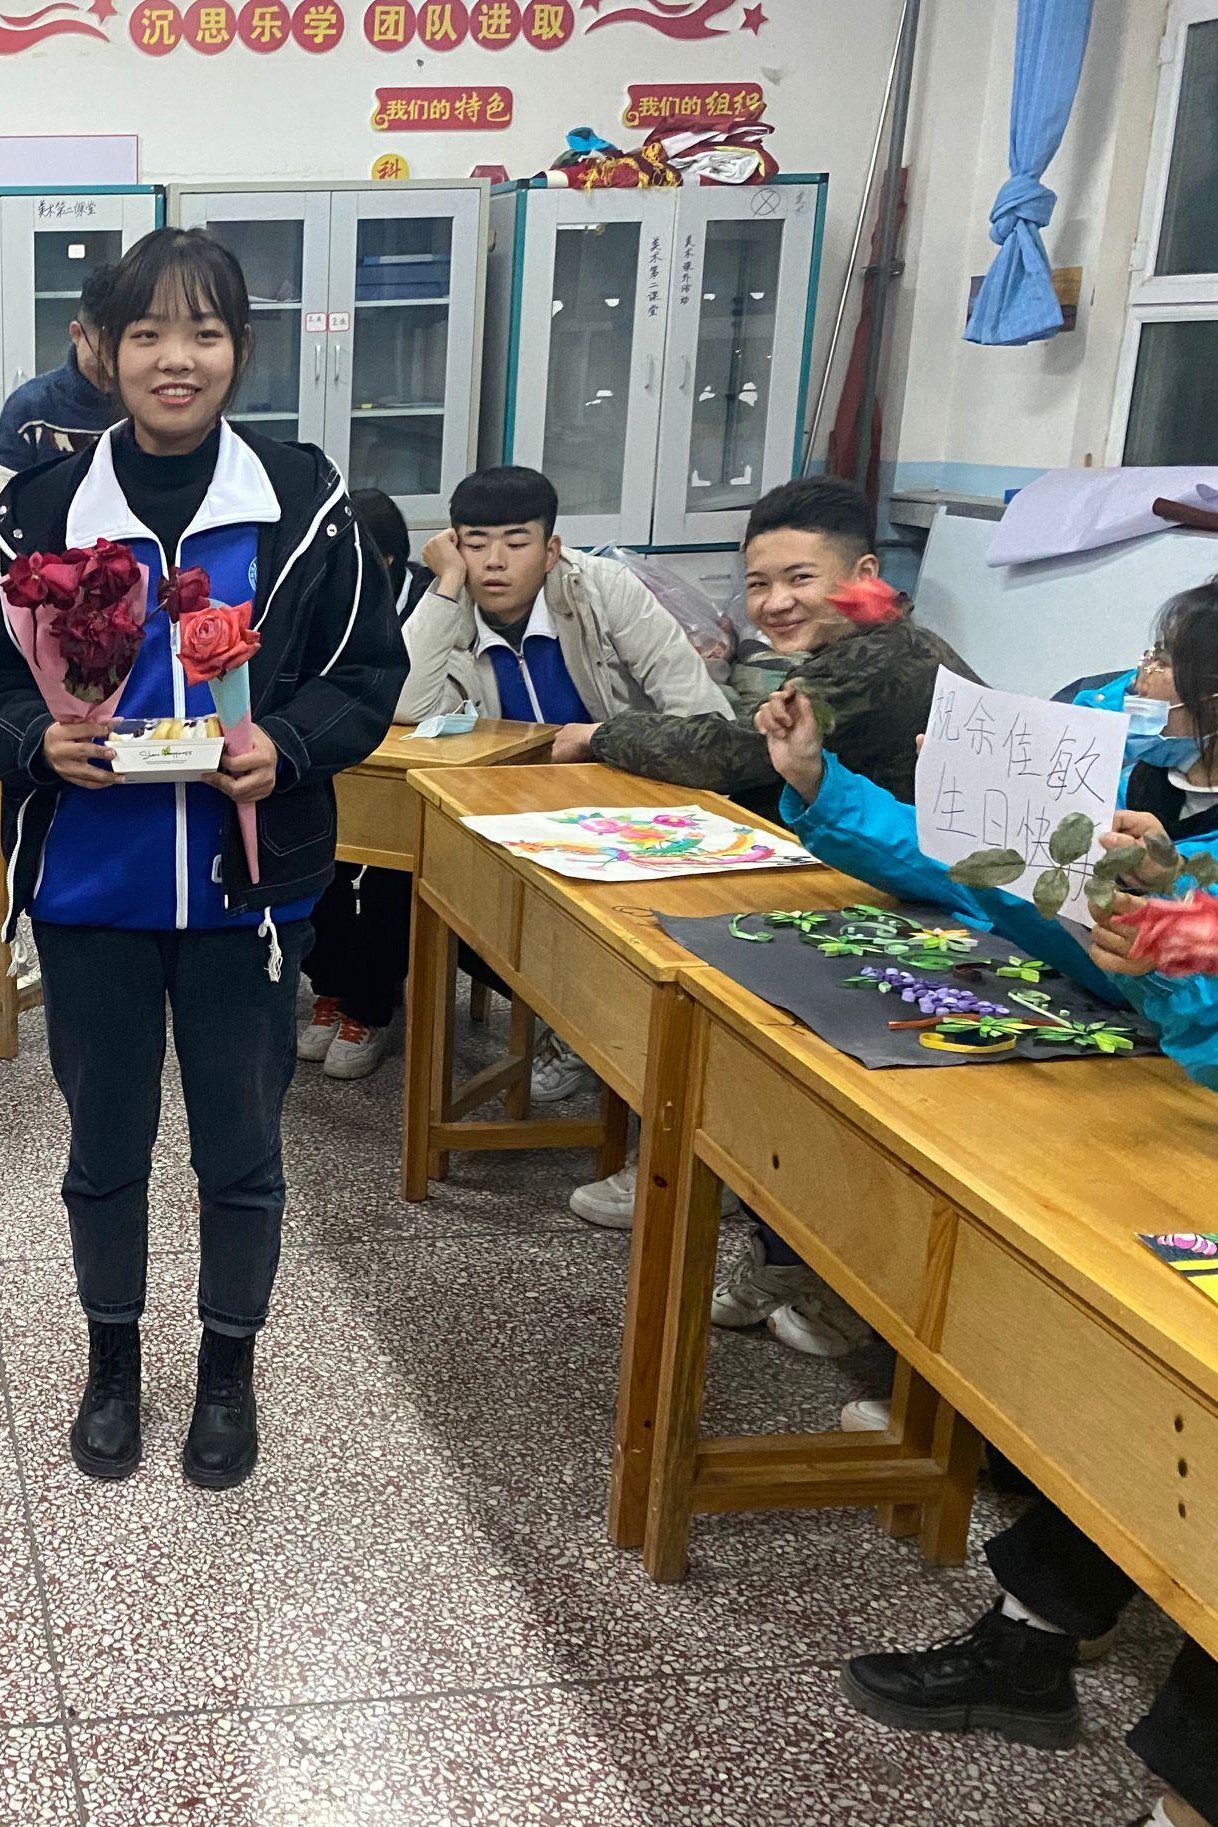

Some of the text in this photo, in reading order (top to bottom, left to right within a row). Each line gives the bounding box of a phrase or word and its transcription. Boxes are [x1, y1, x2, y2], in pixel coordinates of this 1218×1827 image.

[142, 2, 566, 46] 沉思乐学 团队进取
[385, 92, 512, 122] 我们的特色
[646, 236, 663, 318] 美术第二课堂
[931, 690, 1105, 803] 祝余佳敏
